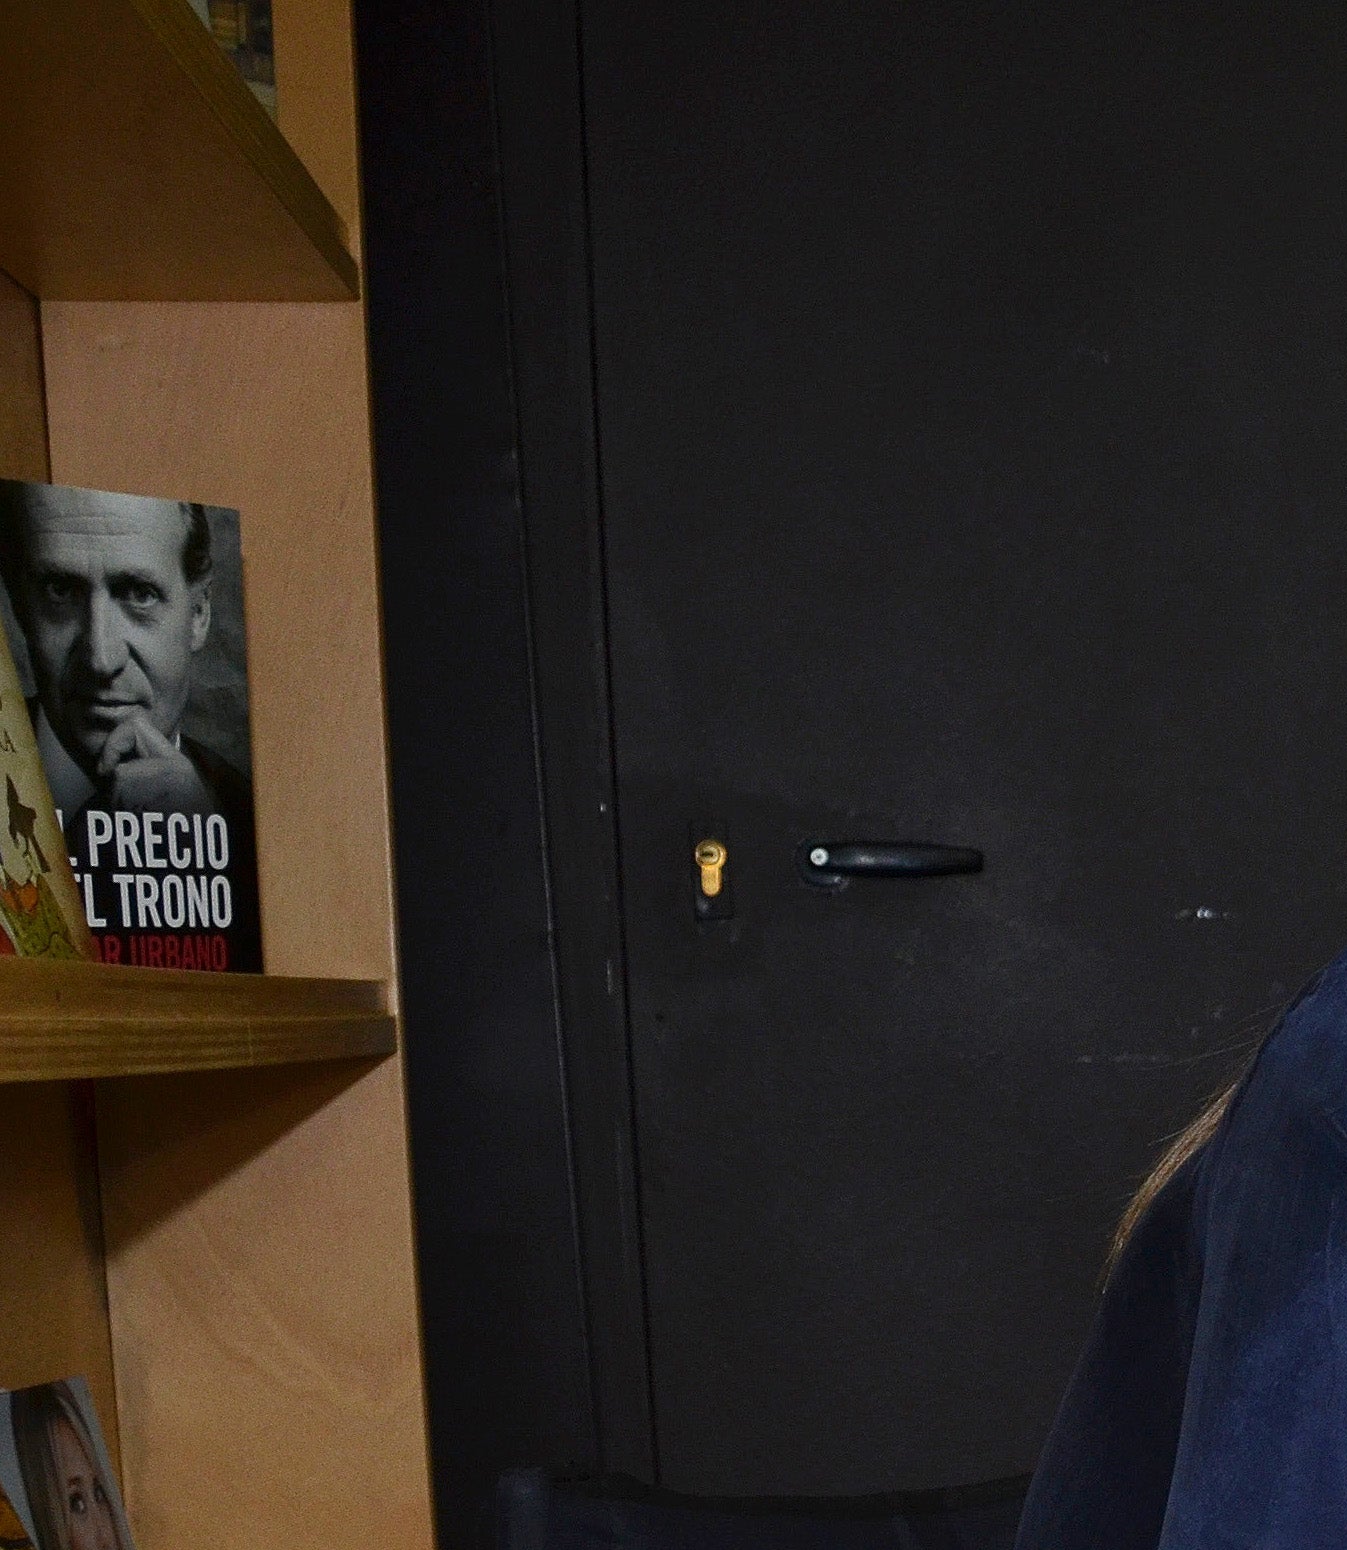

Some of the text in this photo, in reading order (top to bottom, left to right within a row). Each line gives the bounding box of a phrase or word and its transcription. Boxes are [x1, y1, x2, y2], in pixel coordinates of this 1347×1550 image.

[87, 810, 230, 870] PRECIO
[112, 872, 233, 929] TRONO
[130, 934, 228, 971] URBANO
